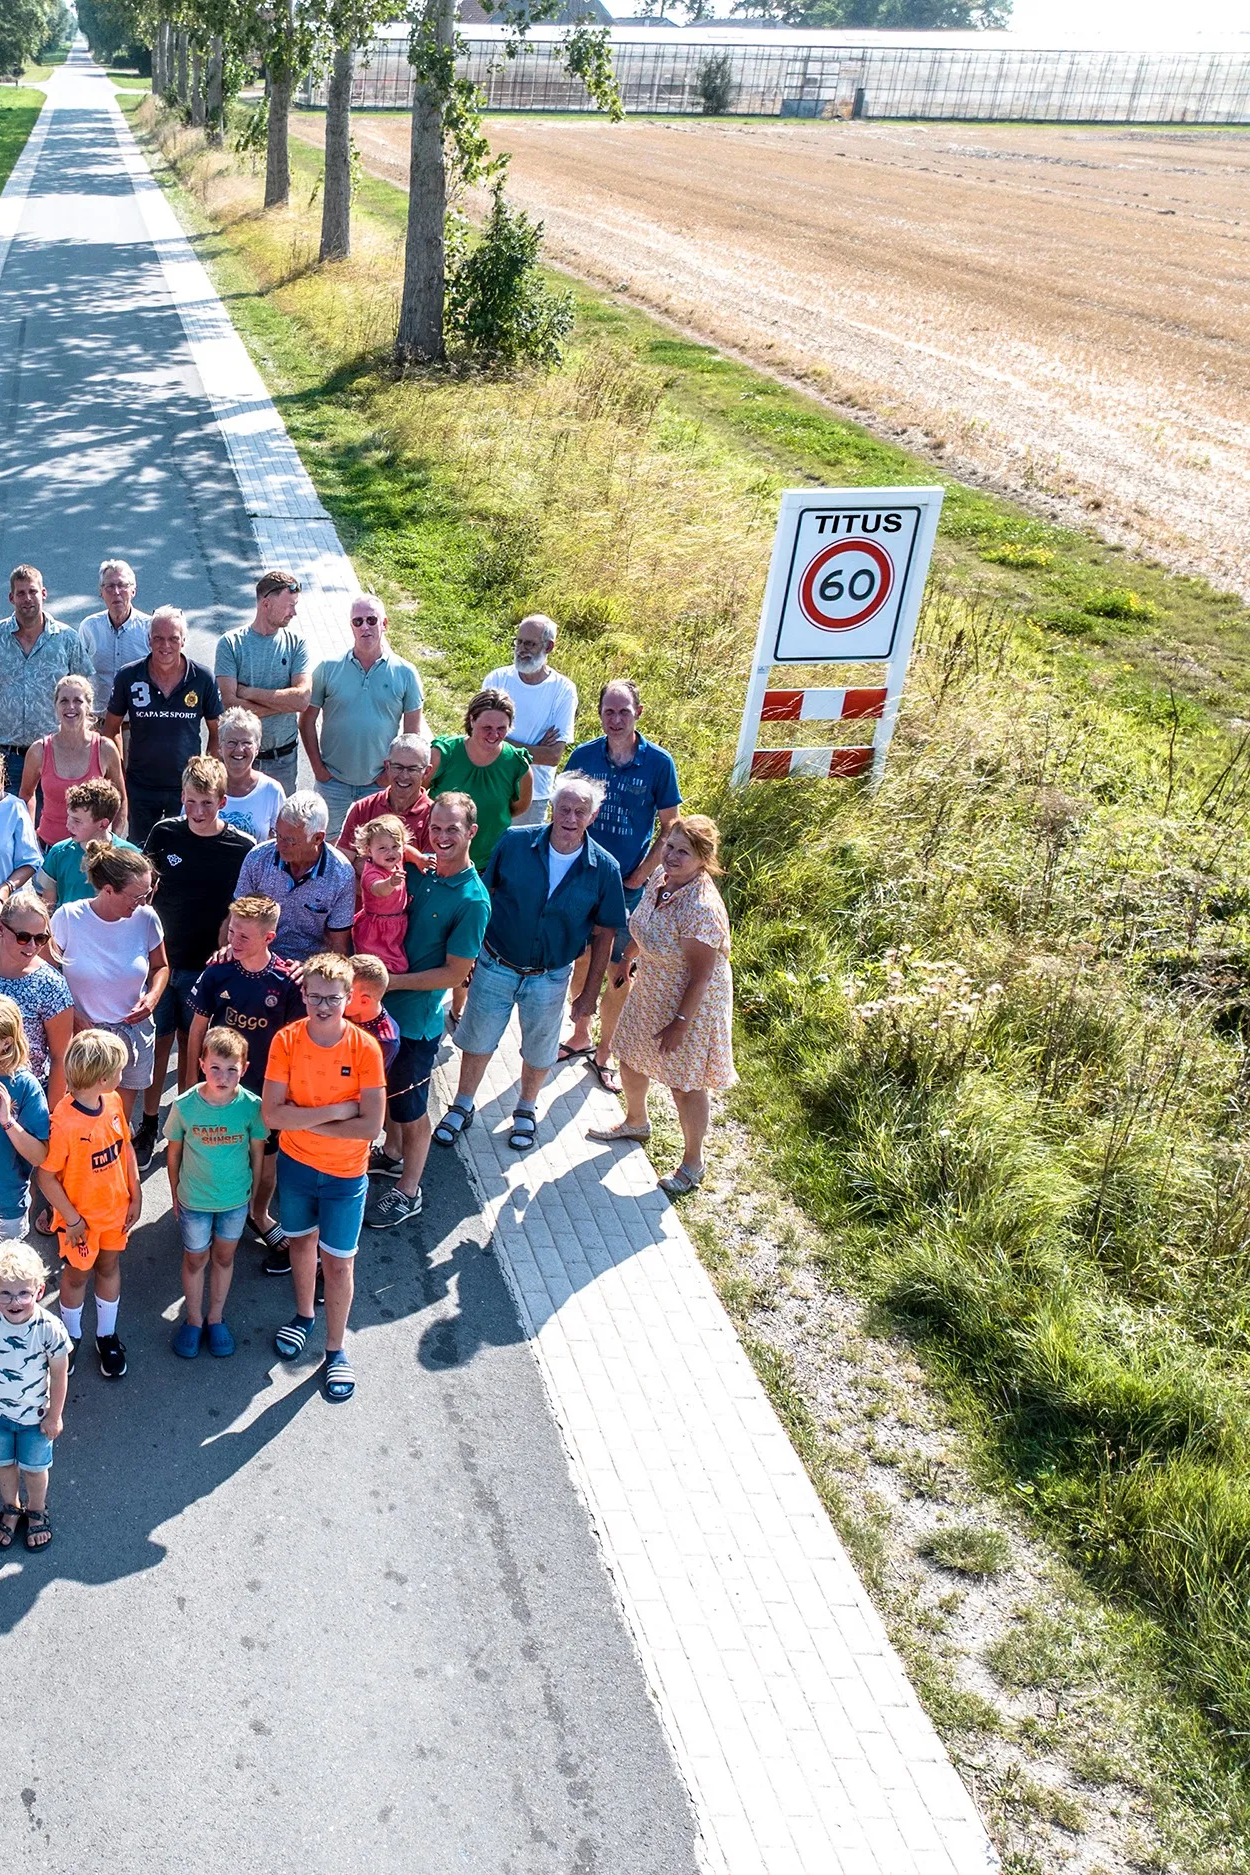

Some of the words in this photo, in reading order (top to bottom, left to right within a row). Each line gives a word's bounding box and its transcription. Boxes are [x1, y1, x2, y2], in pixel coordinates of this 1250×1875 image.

[815, 513, 903, 534] TITUS
[819, 568, 875, 601] 60
[130, 681, 151, 708] 3
[170, 711, 197, 719] SPORTS
[225, 1006, 268, 1030] Ziggo
[192, 1126, 228, 1137] CAMP
[201, 1134, 245, 1147] SUNSET
[93, 1152, 108, 1166] TM
